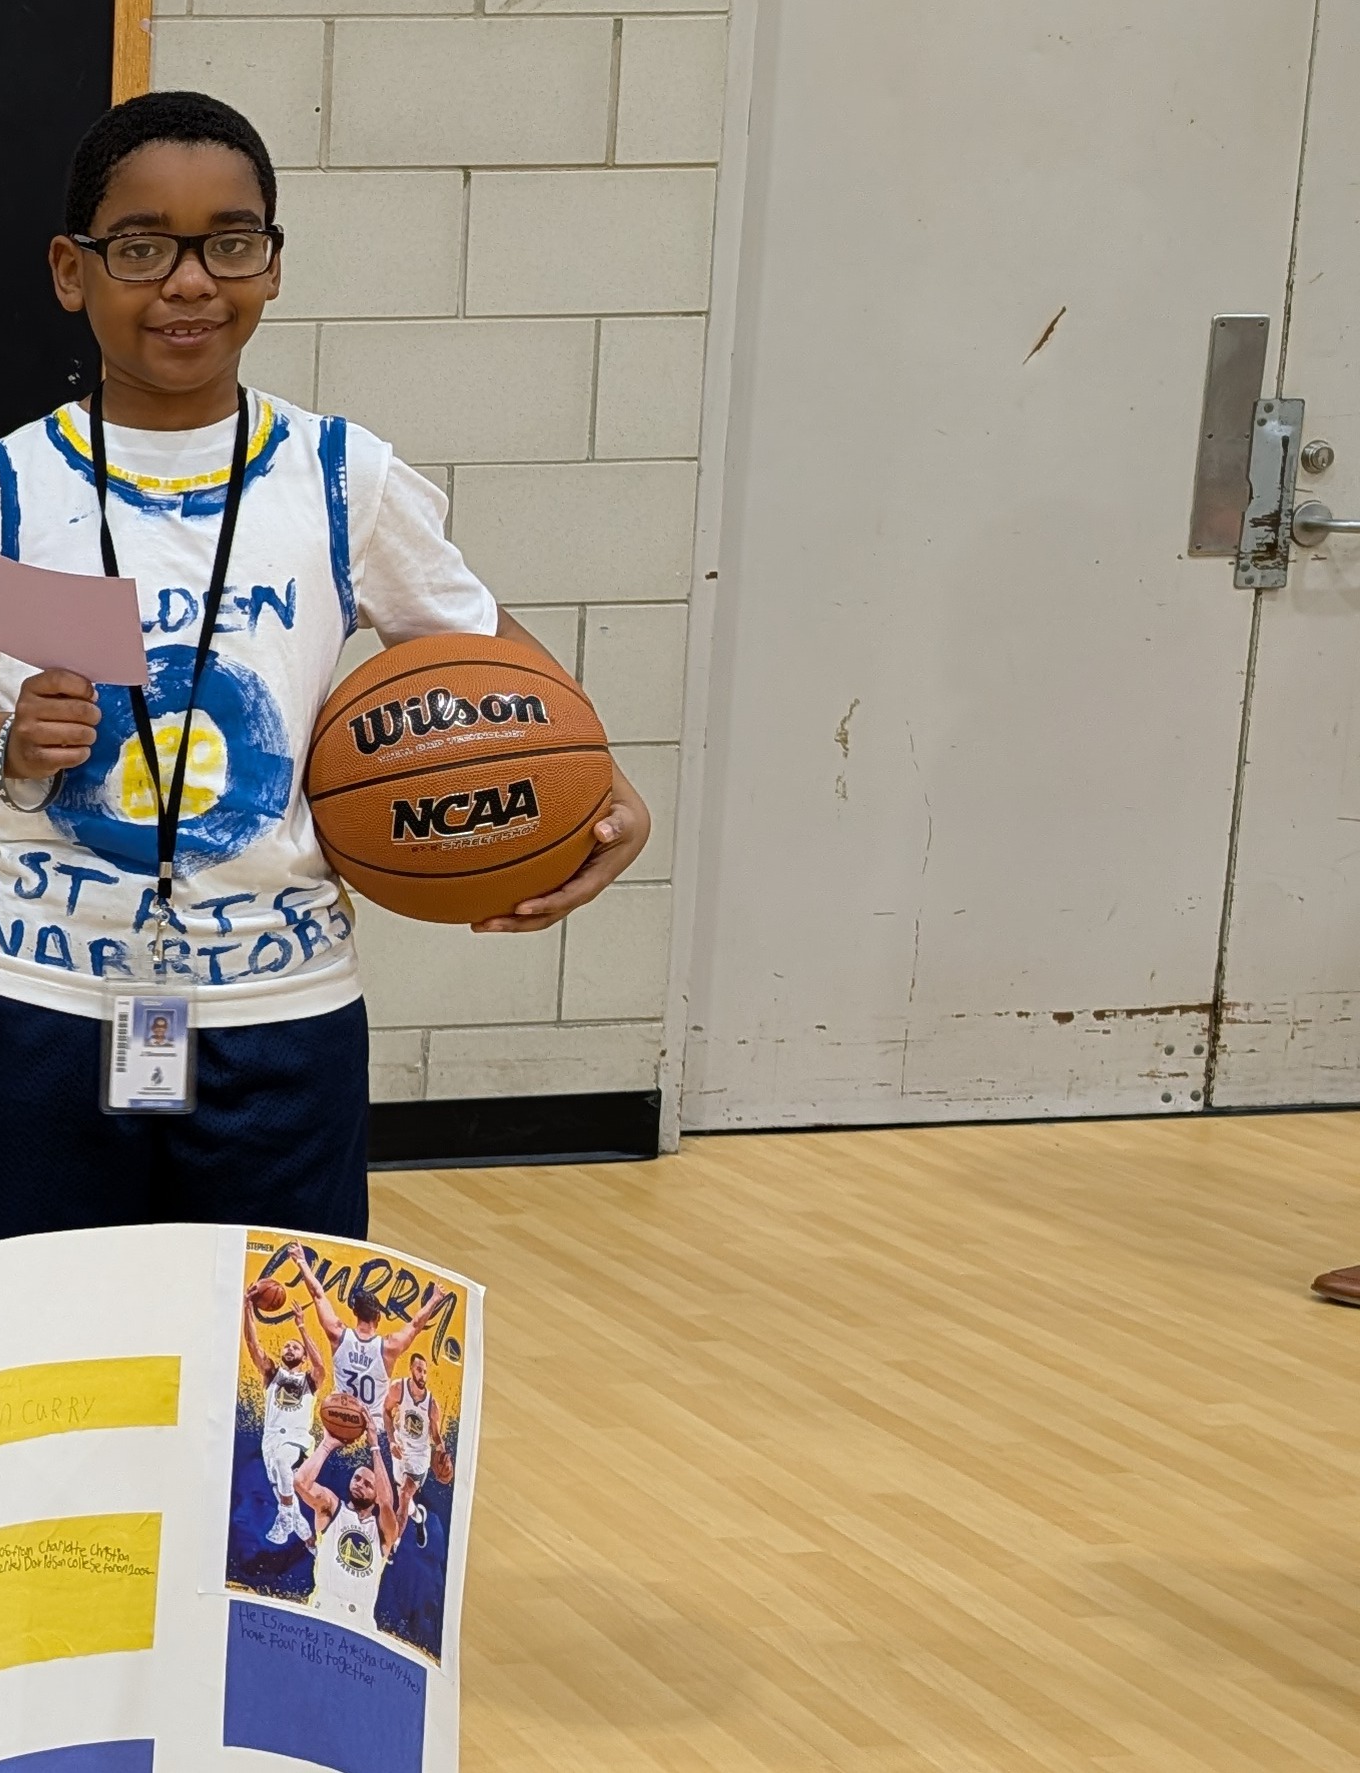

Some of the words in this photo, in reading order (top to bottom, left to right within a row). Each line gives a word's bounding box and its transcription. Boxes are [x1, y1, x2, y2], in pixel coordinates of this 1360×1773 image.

[346, 686, 550, 756] Wilson
[391, 777, 541, 842] NCAA
[342, 1369, 375, 1404] 30
